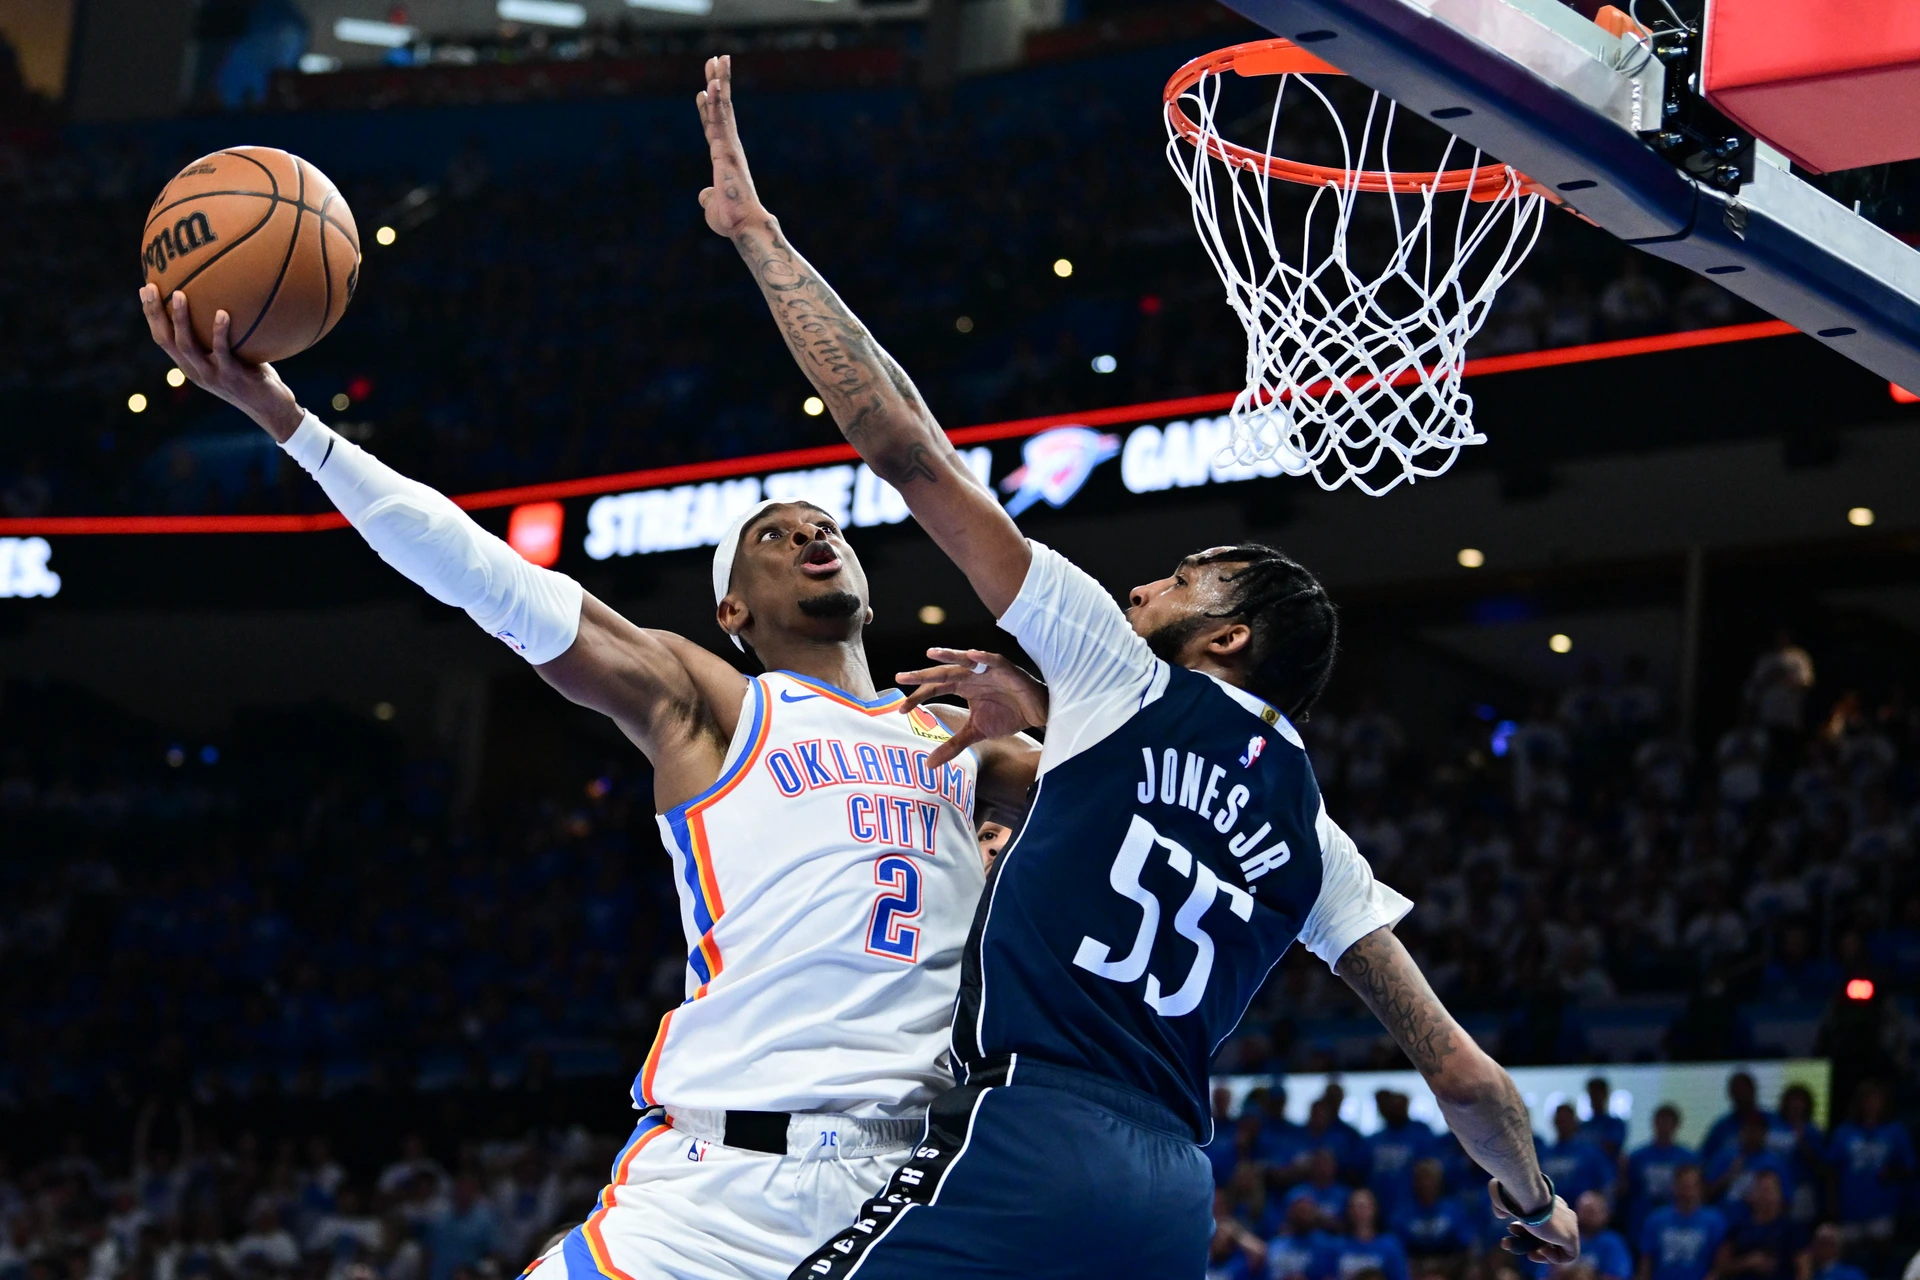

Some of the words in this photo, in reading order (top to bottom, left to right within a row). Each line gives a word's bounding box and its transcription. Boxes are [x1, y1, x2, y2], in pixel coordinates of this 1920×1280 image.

[847, 793, 940, 855] CITY
[1137, 747, 1250, 834] JONES
[865, 853, 922, 963] 2
[1072, 813, 1254, 1017] 55
